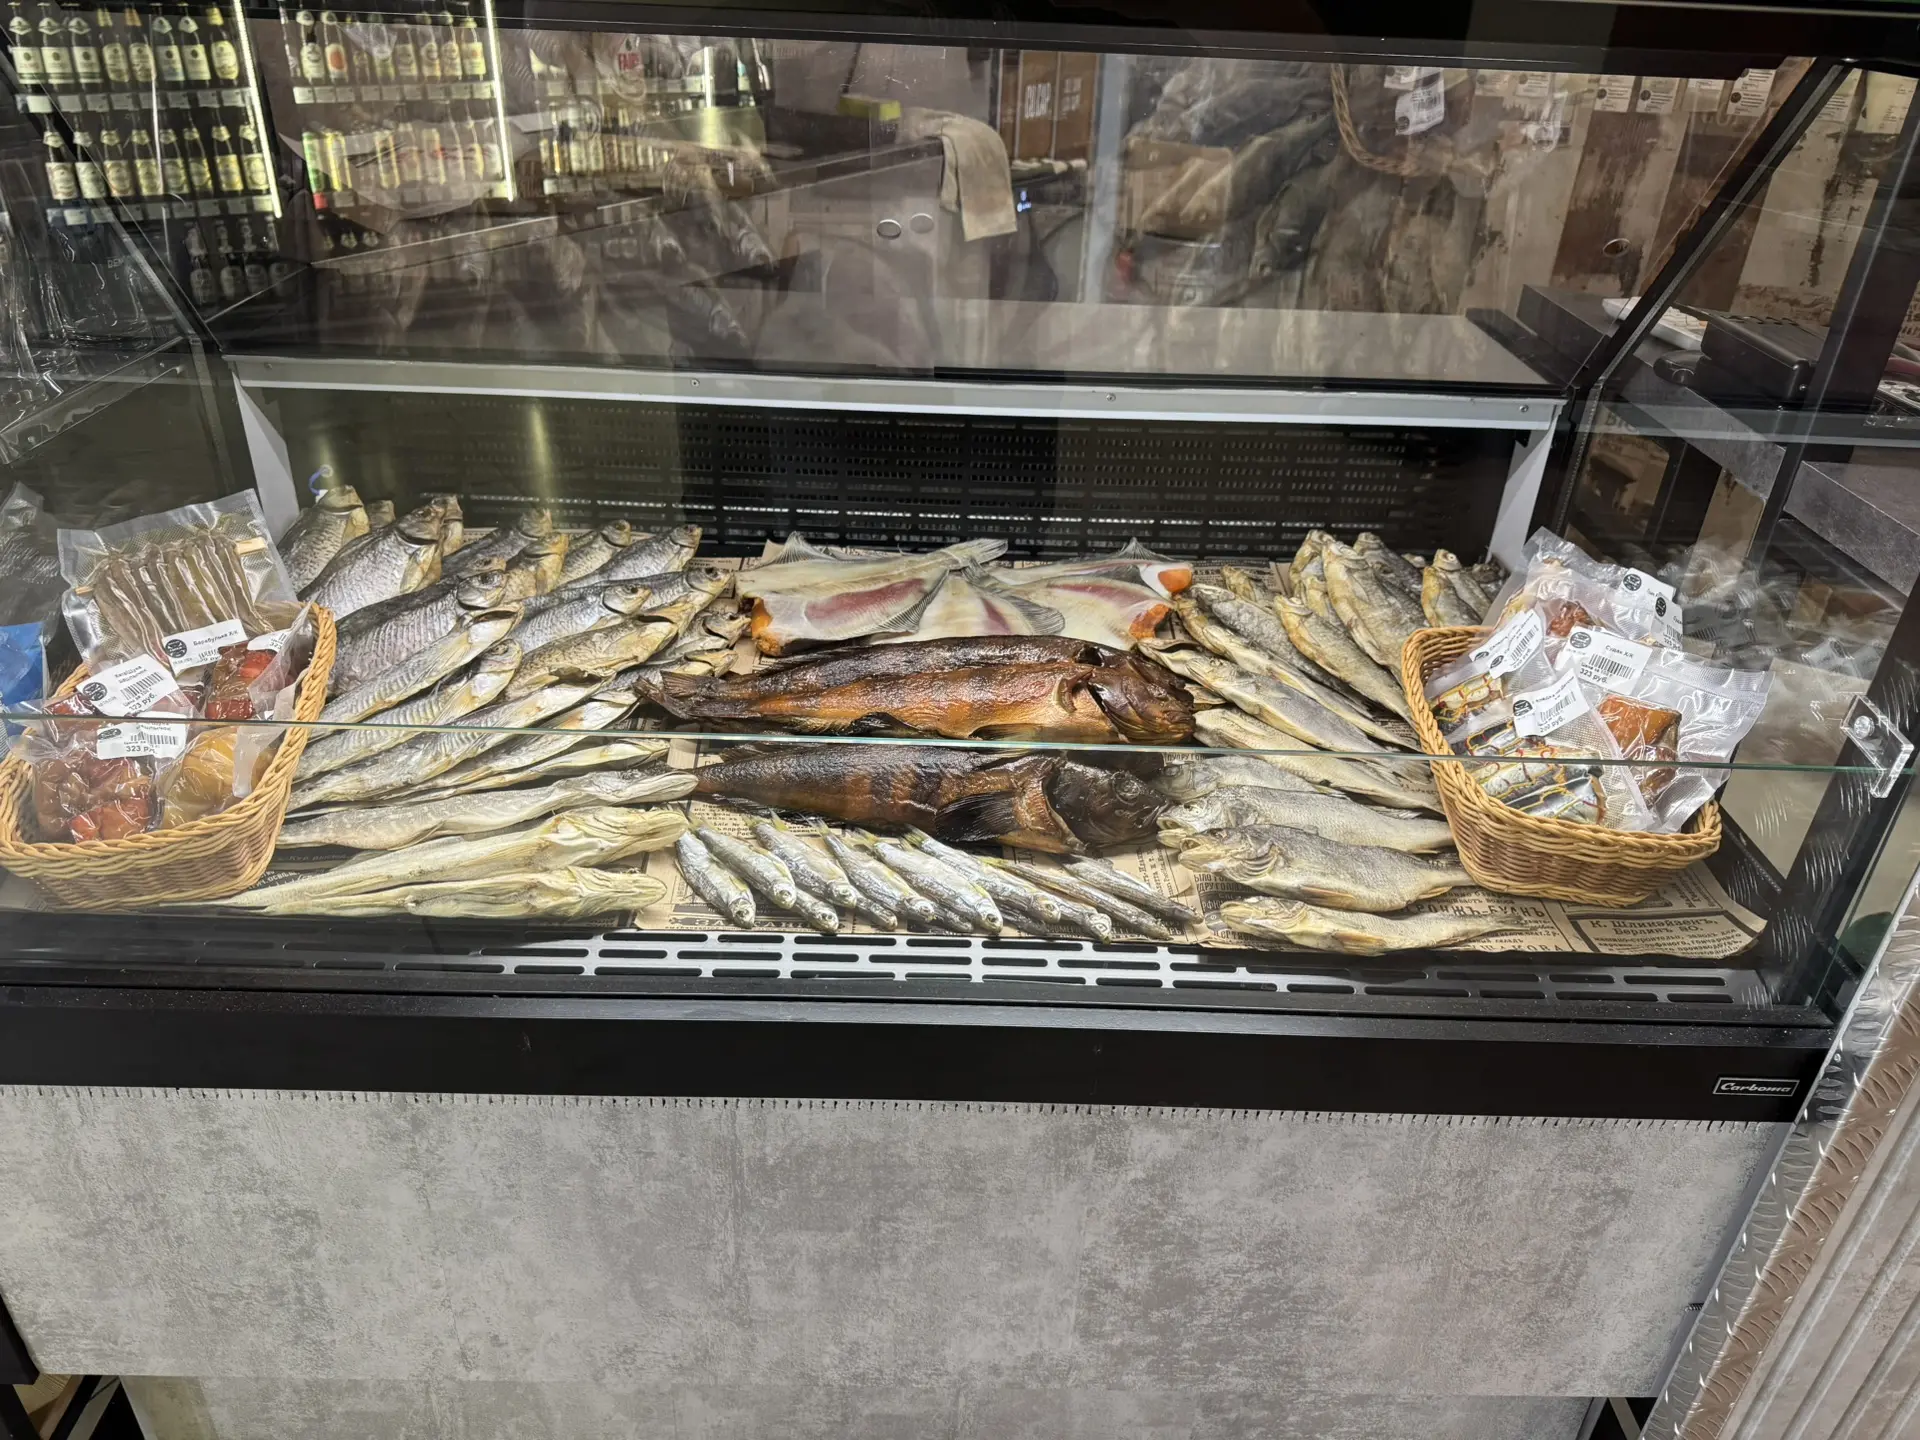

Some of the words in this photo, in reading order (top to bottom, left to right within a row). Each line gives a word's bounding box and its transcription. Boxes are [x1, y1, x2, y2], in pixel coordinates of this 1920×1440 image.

[1580, 667, 1592, 678] 323
[1592, 674, 1608, 684] руб.
[126, 745, 141, 753] 323
[1720, 1082, 1792, 1092] Carboma
